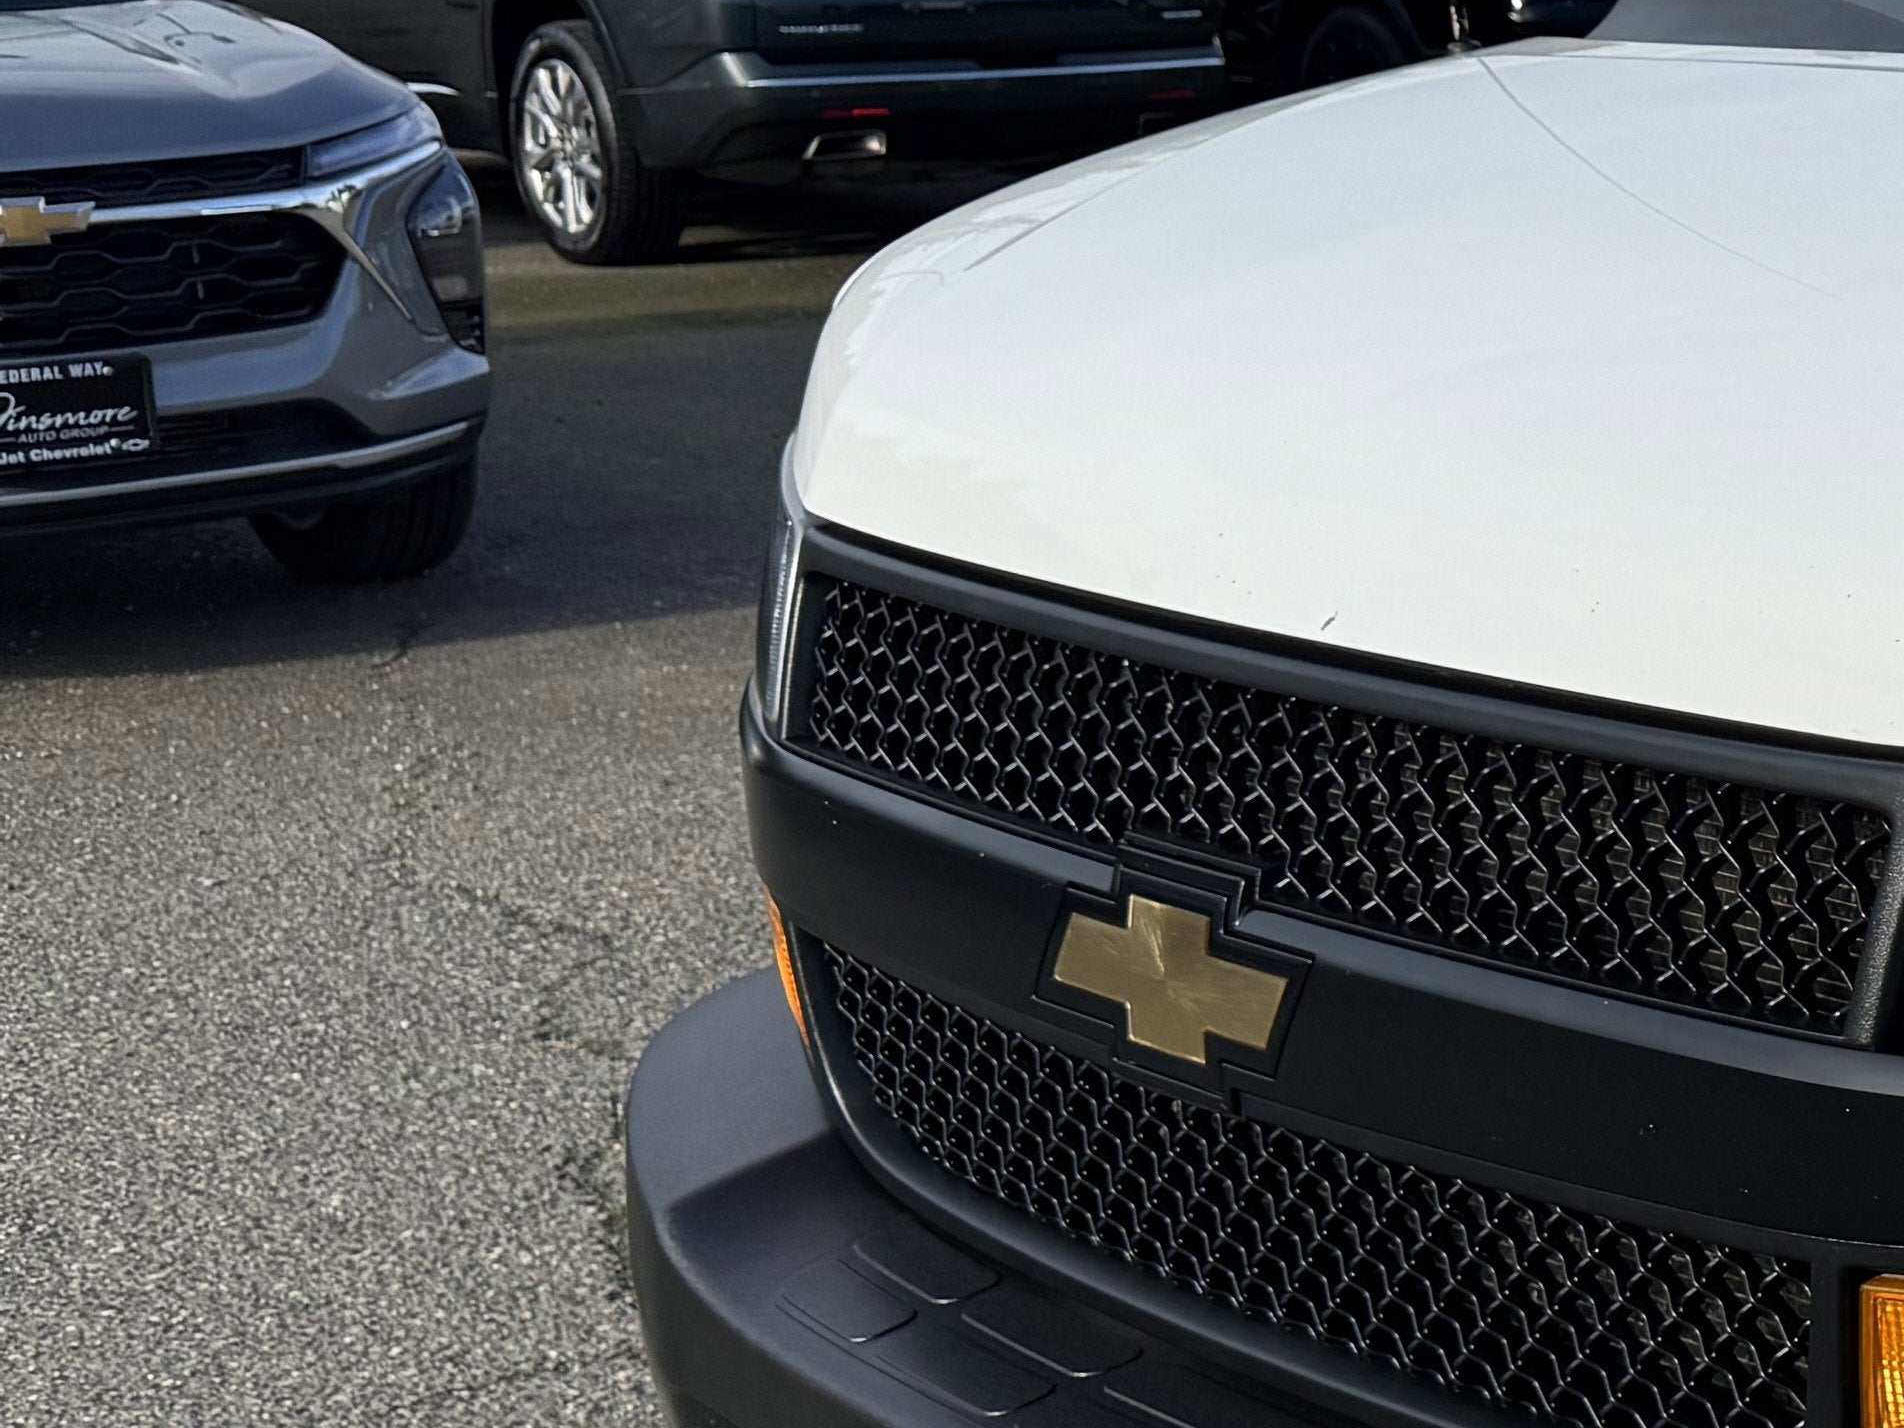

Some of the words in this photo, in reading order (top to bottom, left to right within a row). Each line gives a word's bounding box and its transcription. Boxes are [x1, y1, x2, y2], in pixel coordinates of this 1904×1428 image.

[0, 366, 64, 384] EDERAL
[68, 361, 103, 378] WAY
[18, 430, 57, 444] AUTO
[59, 425, 110, 440] GROUP
[0, 451, 26, 465] Jet
[29, 442, 112, 462] Chevrolet
